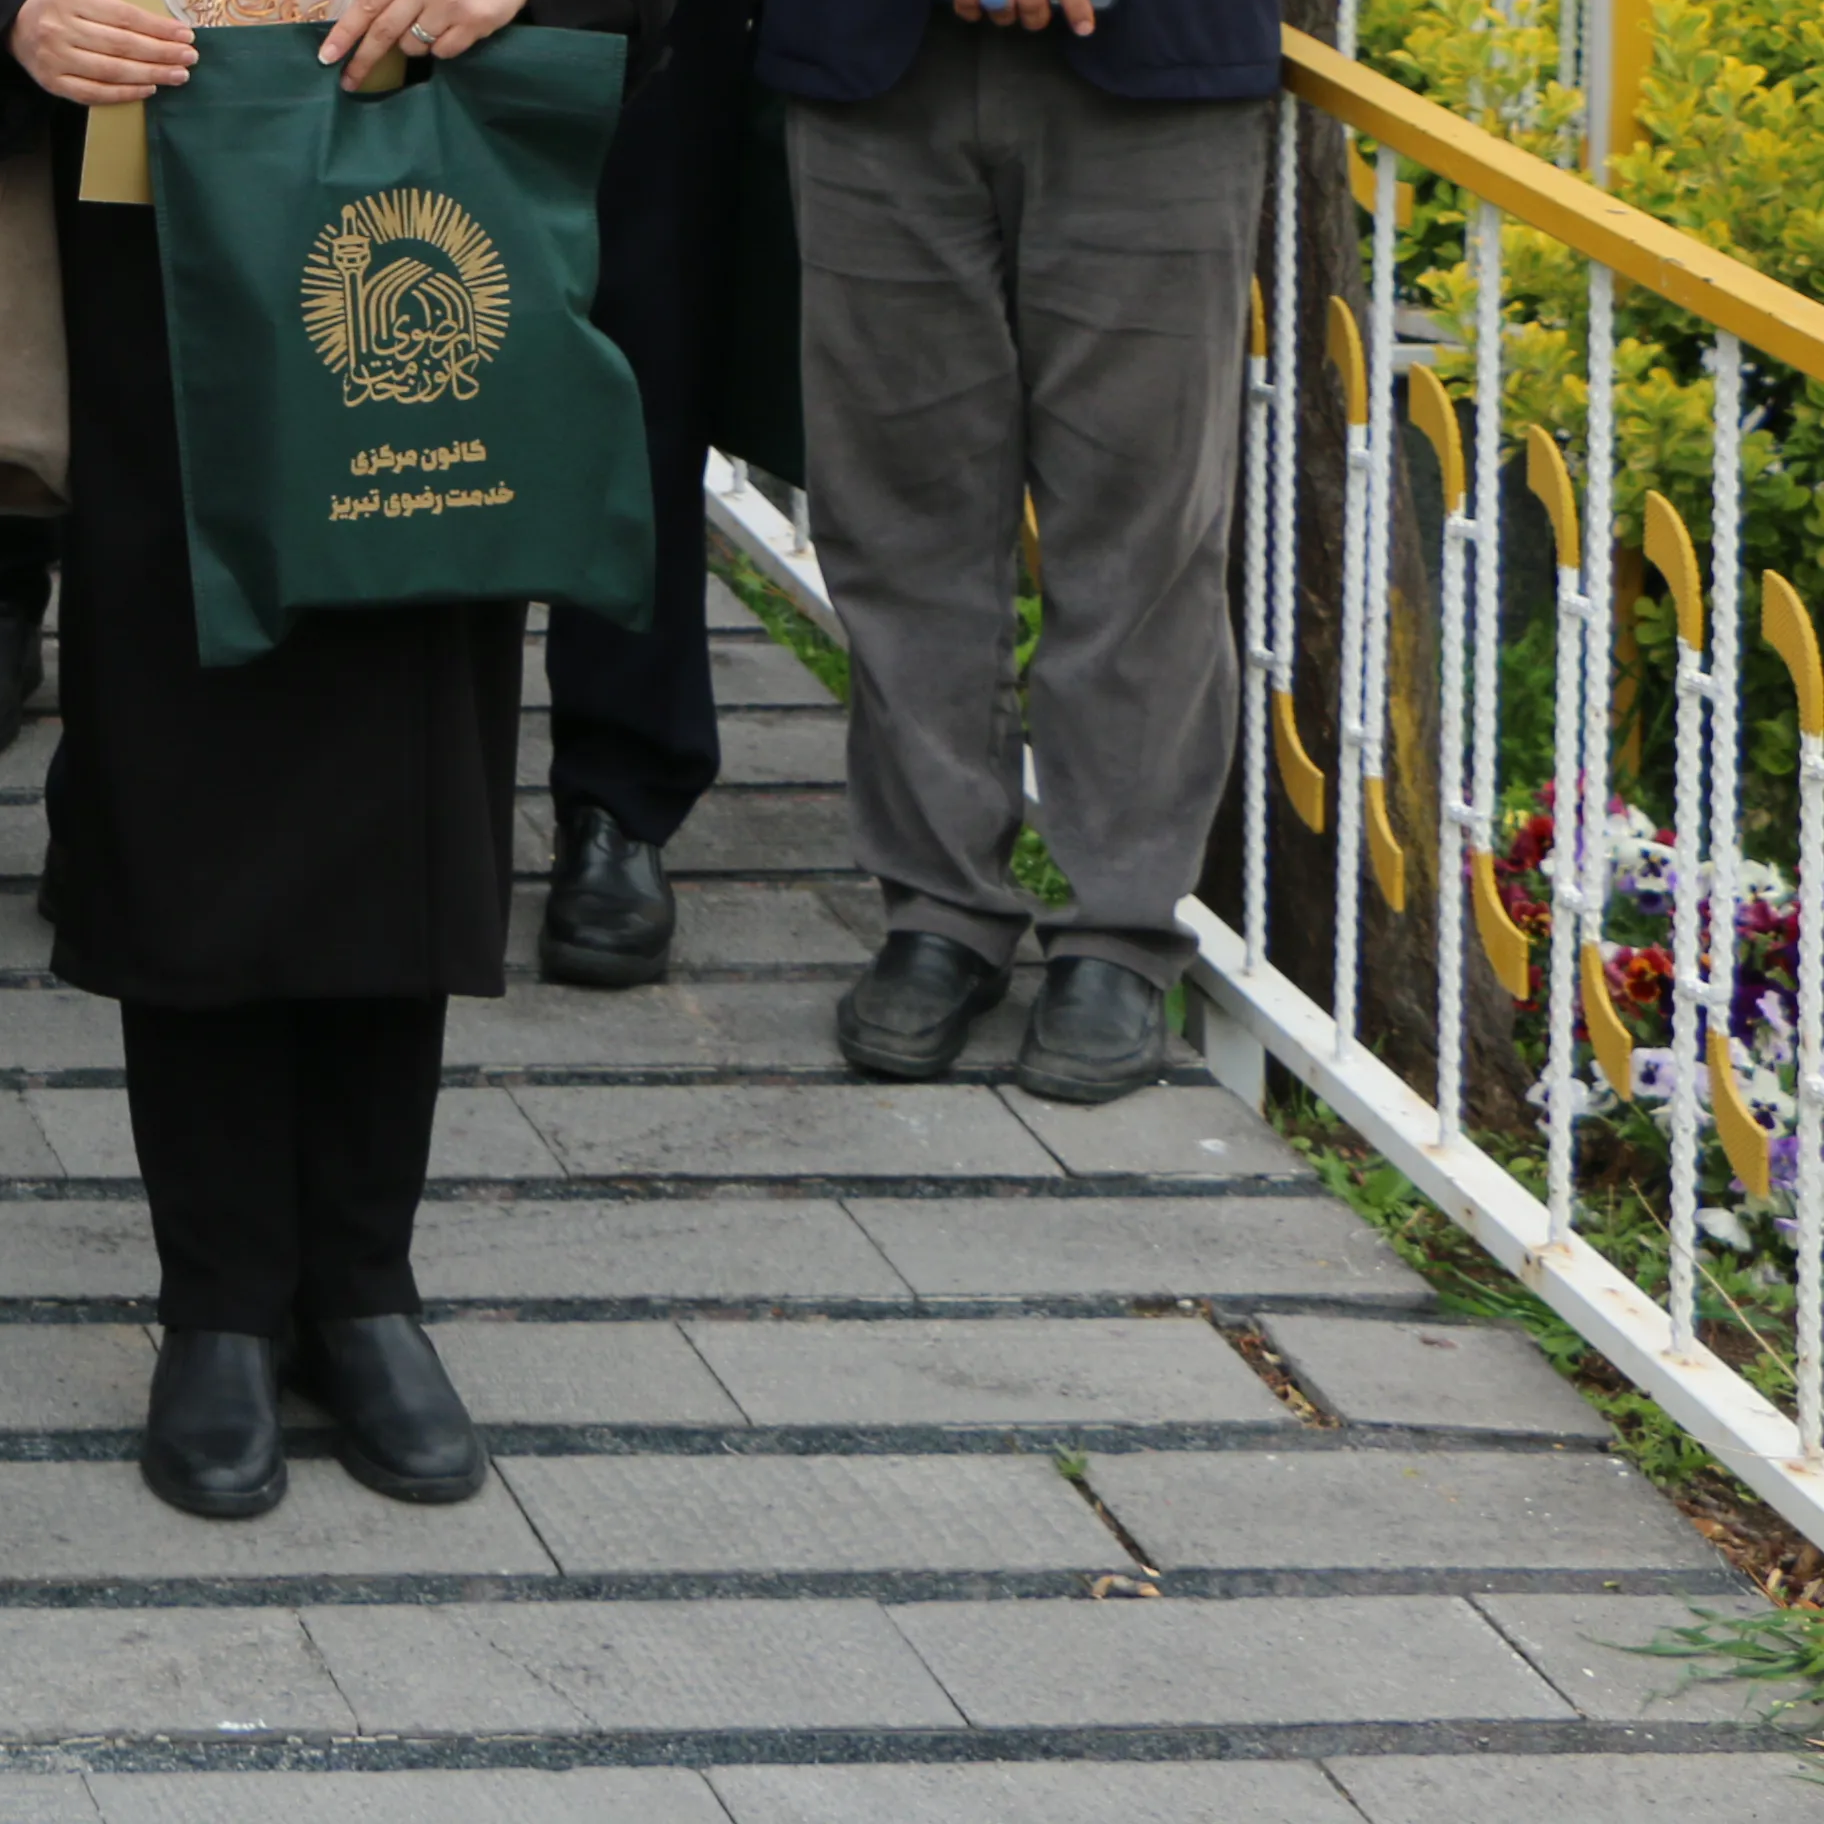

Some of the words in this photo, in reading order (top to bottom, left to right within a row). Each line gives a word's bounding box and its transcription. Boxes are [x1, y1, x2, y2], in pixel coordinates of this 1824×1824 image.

[350, 443, 418, 476] مرکزی
[420, 439, 487, 472] کانون
[328, 489, 381, 521] تبریز
[383, 485, 443, 518] رضوی
[445, 481, 516, 508] خدمت
